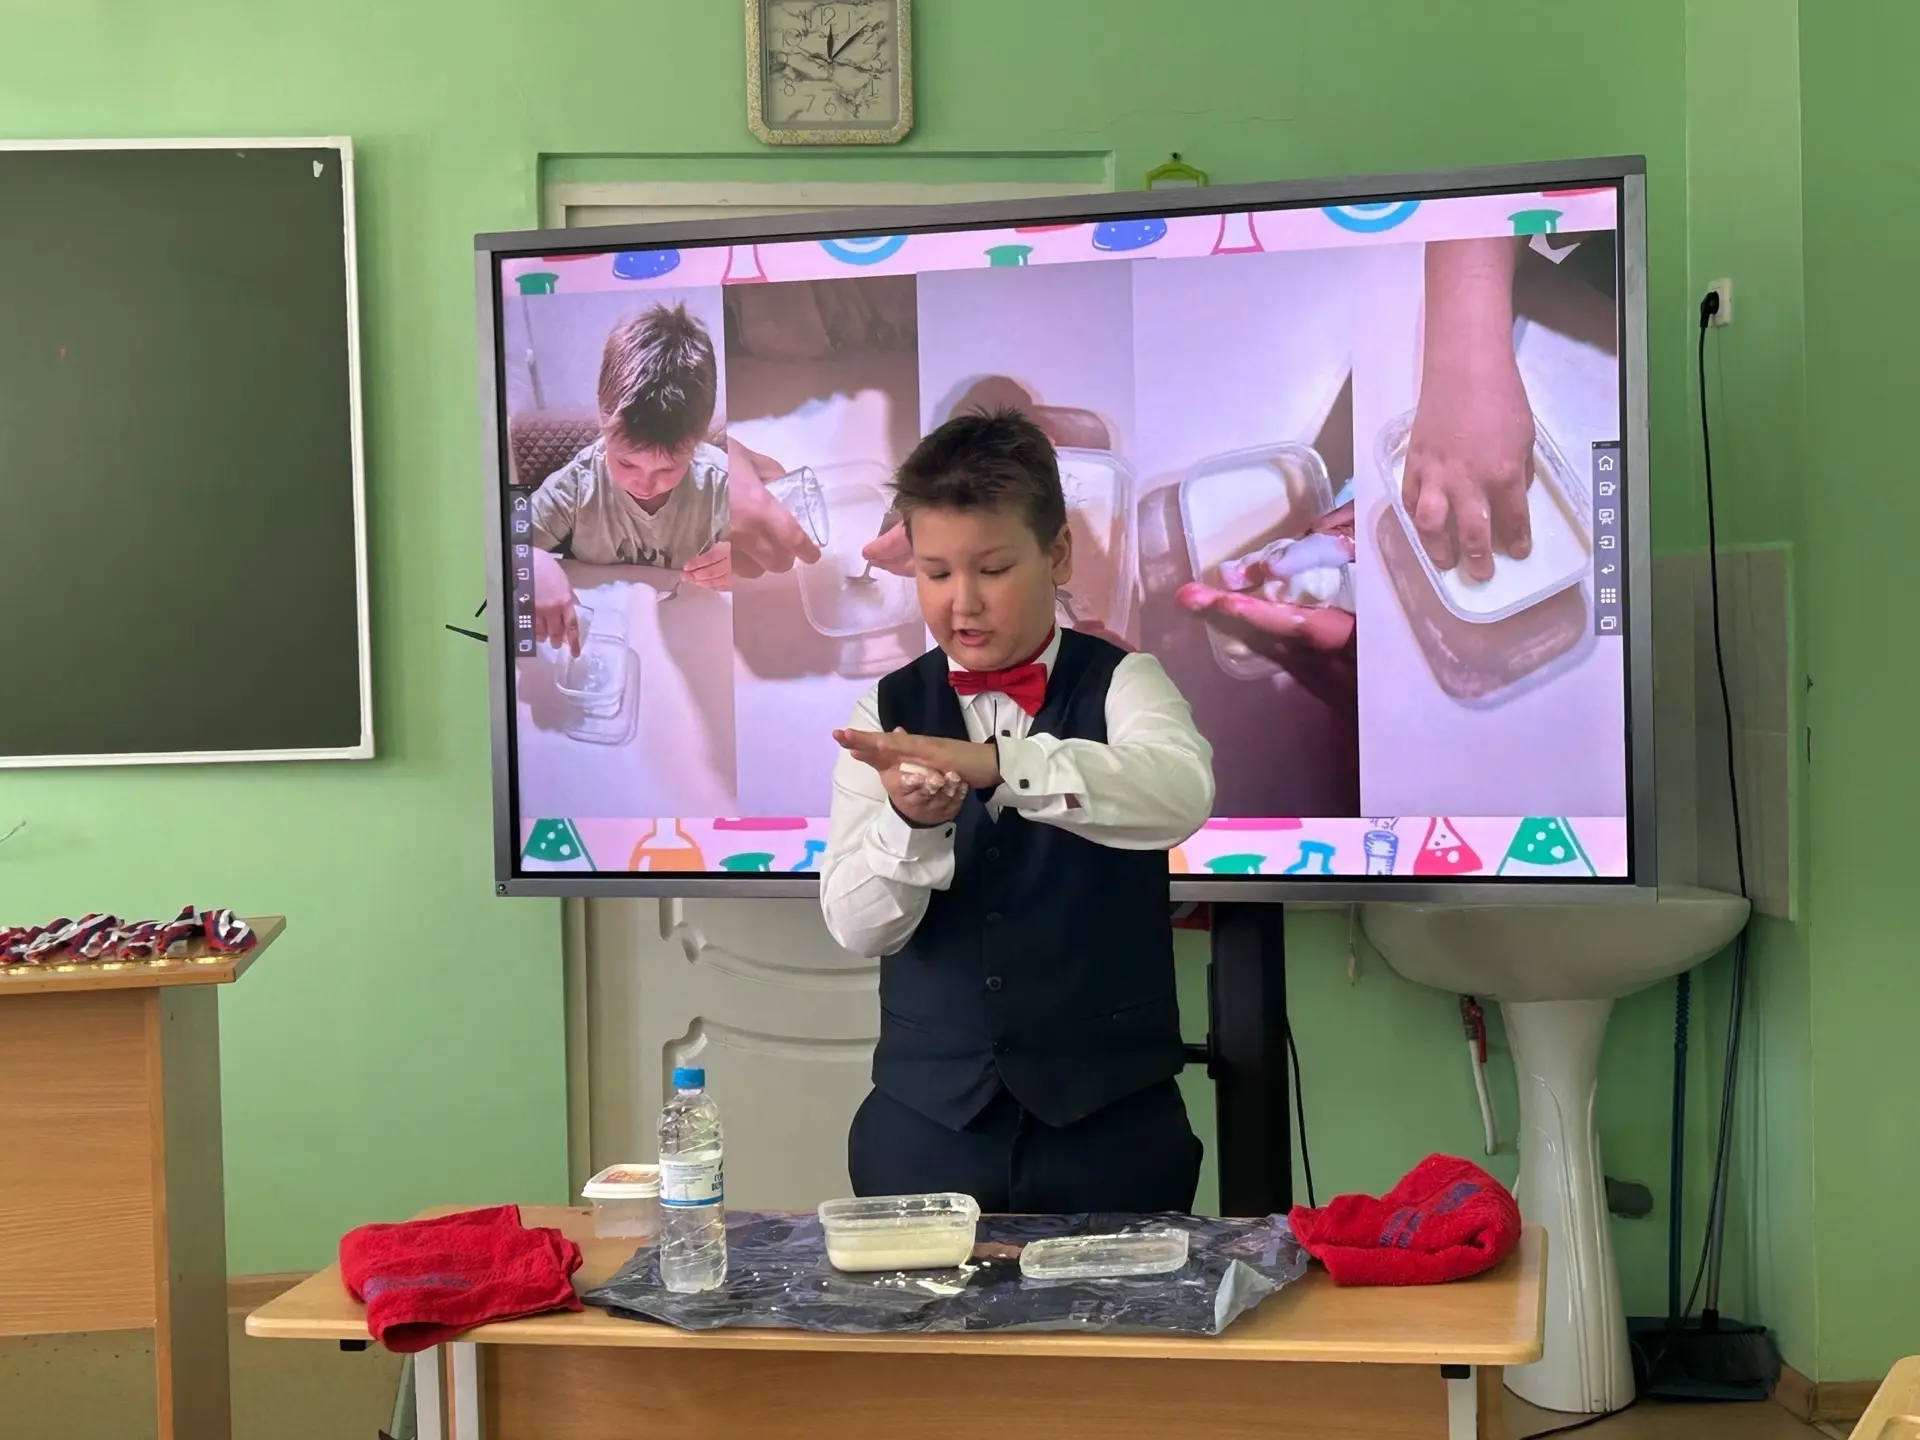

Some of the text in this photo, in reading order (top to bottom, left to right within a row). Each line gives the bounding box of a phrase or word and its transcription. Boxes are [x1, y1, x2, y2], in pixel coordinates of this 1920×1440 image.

[820, 7, 836, 26] 12
[781, 28, 802, 47] 10
[783, 77, 796, 97] 8
[803, 94, 816, 113] 7
[824, 96, 837, 116] 6
